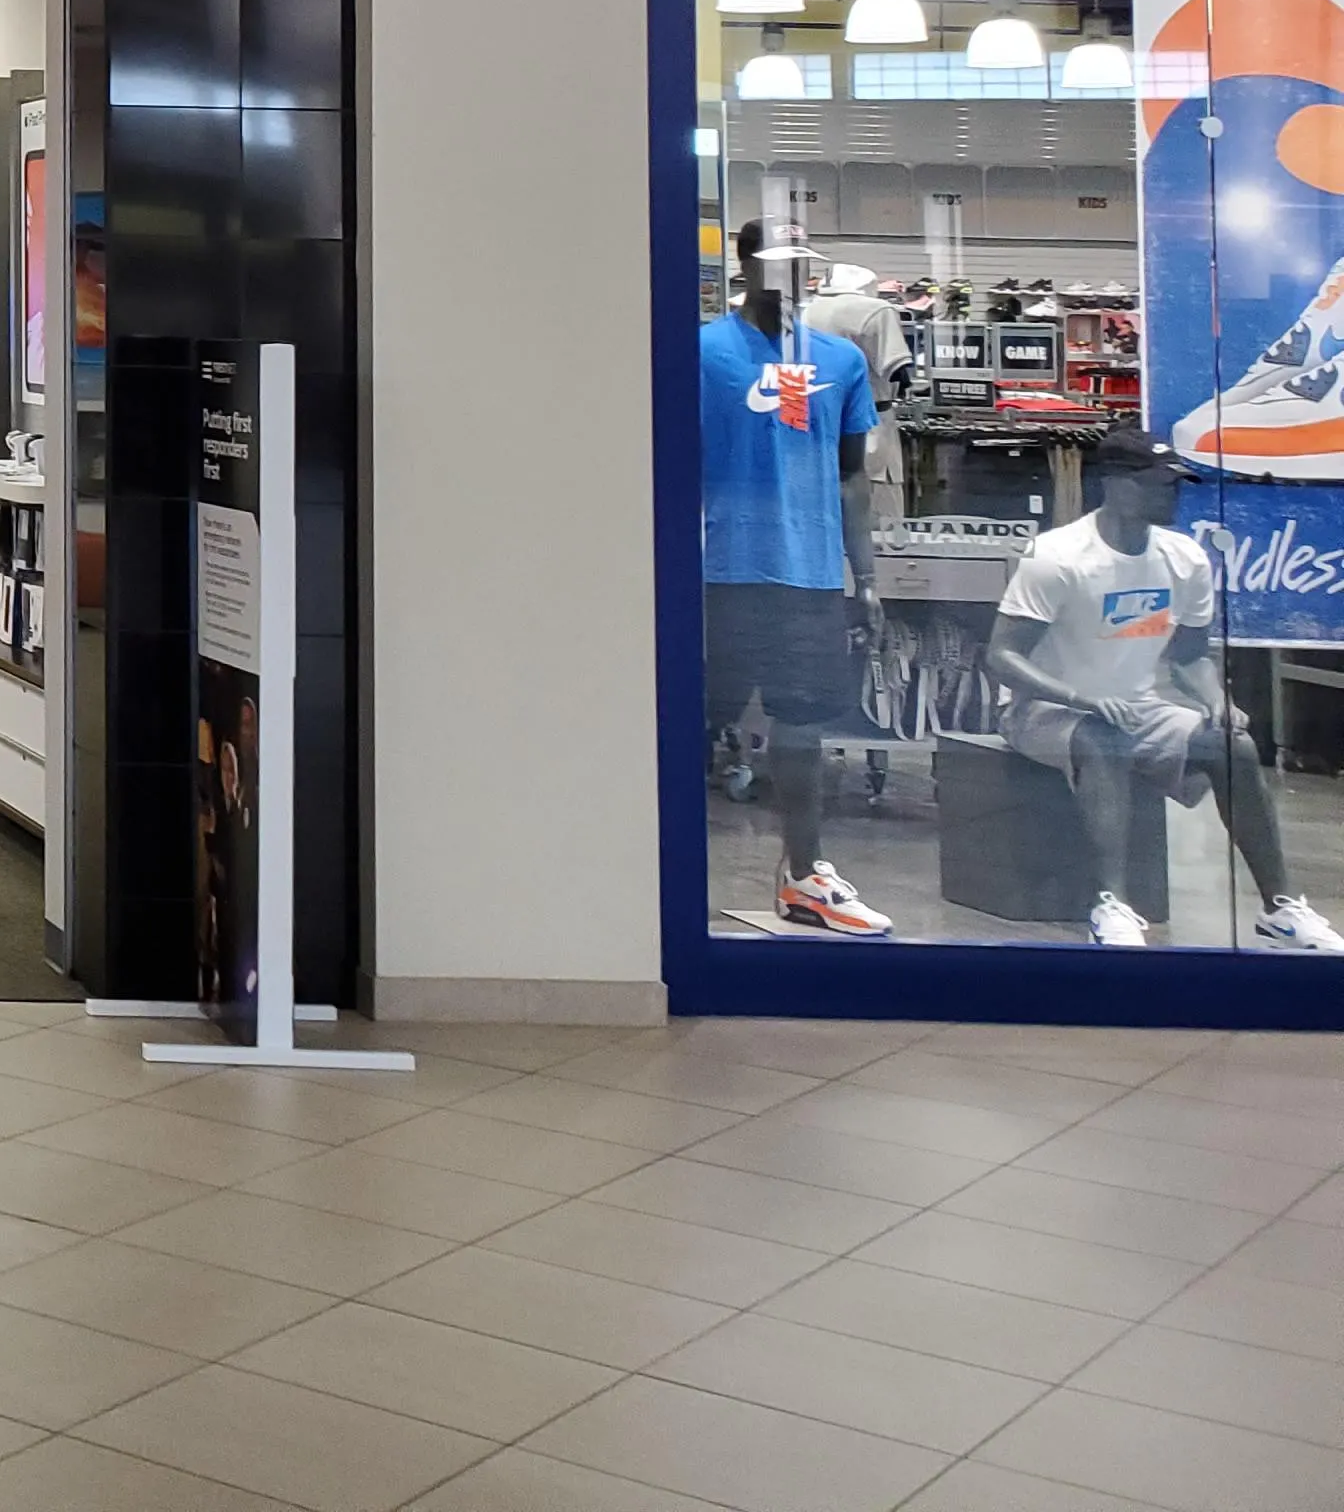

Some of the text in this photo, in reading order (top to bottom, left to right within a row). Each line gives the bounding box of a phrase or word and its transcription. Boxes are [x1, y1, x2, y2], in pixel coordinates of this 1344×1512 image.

[790, 190, 818, 203] KDS
[1077, 197, 1108, 209] KIDS
[935, 345, 1048, 361] KNOW GAME
[203, 407, 252, 436] Putting first
[203, 458, 221, 481] first
